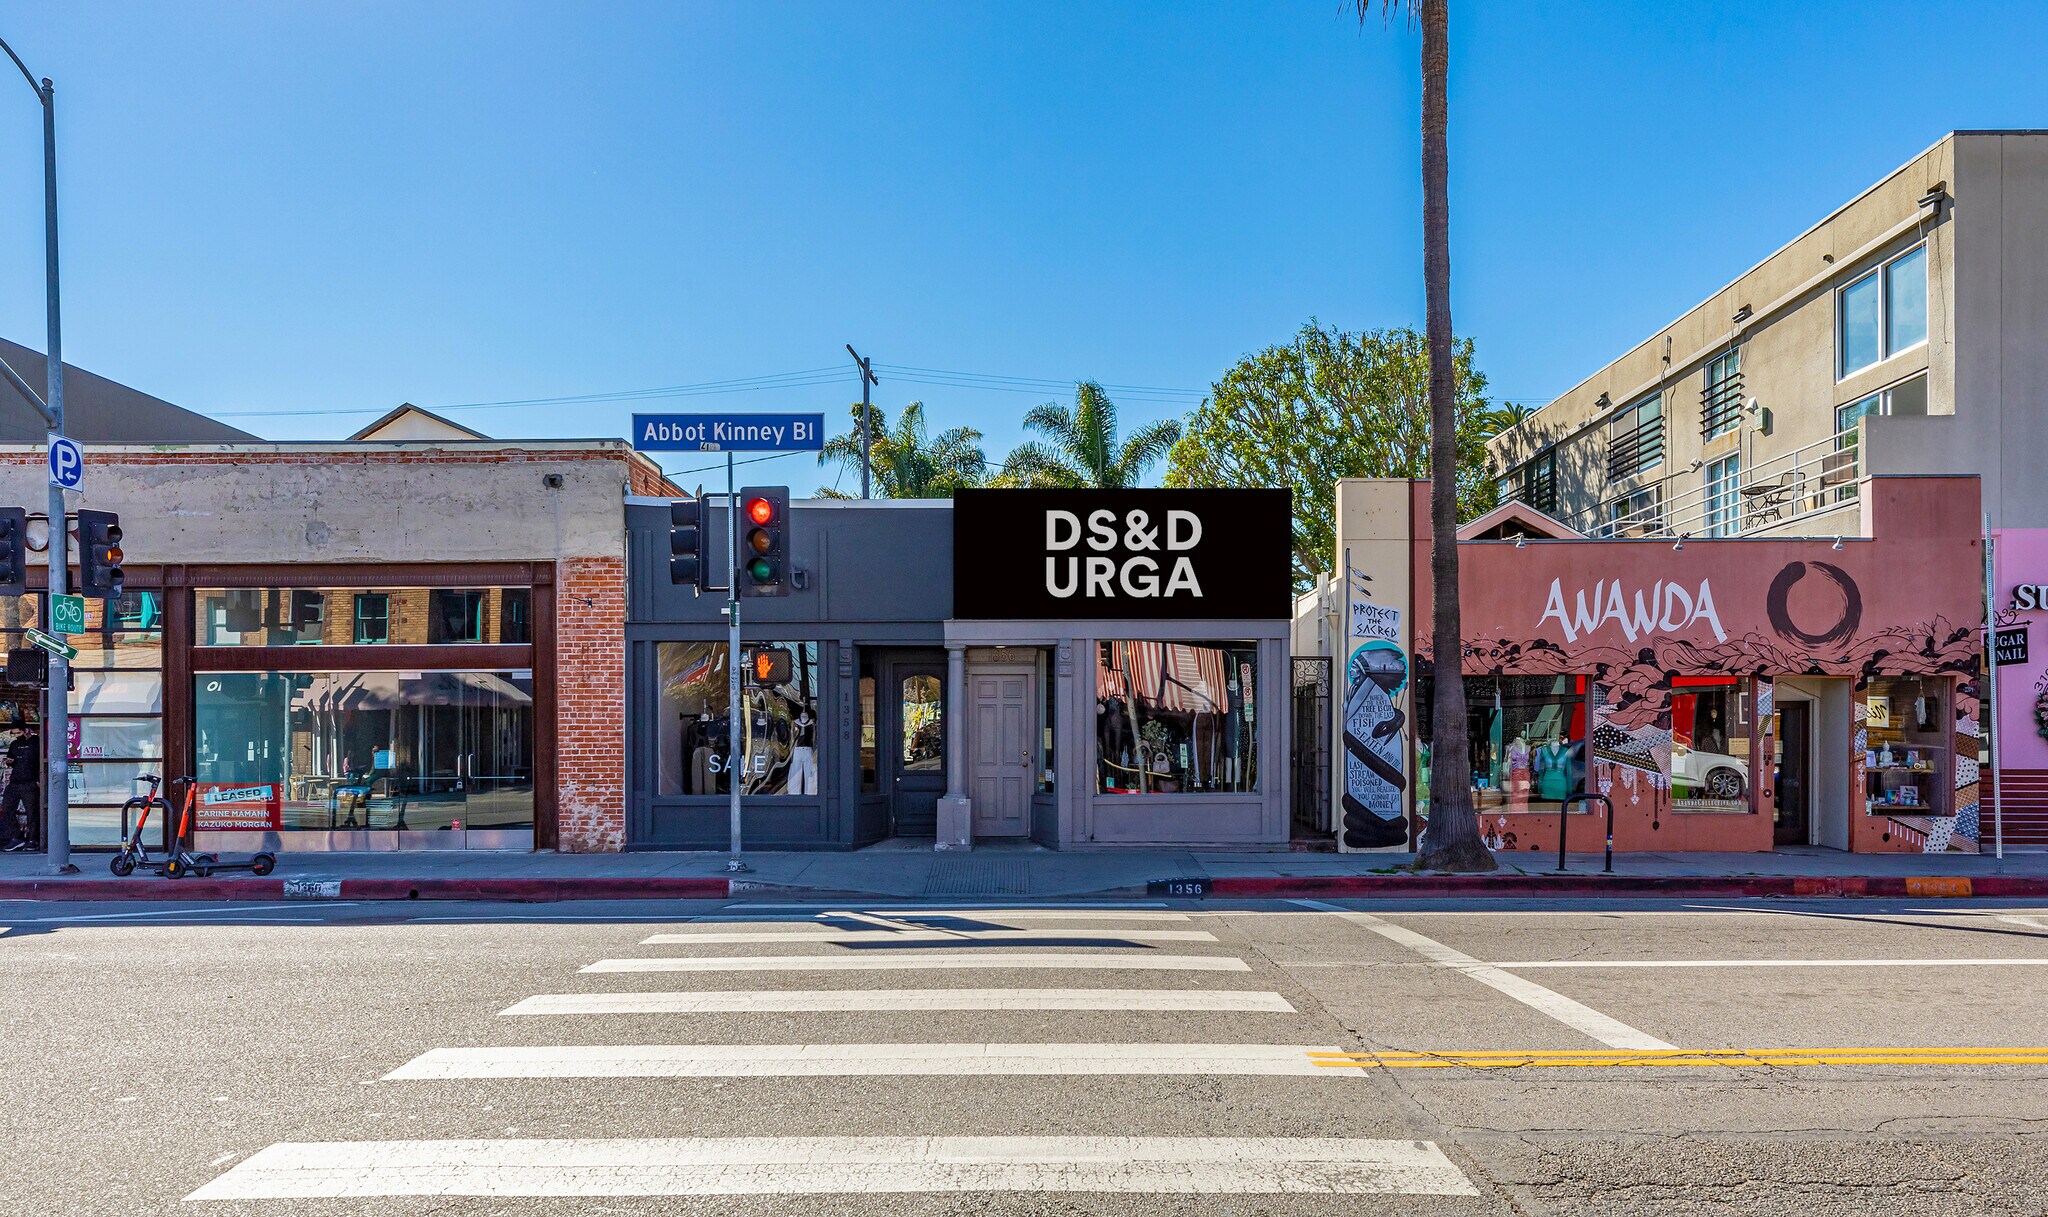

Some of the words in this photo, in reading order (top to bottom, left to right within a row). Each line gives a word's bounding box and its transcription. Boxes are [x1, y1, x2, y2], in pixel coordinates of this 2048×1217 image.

[643, 422, 706, 441] Abbot
[713, 422, 785, 446] Kinney
[57, 443, 77, 480] P
[1046, 509, 1203, 551] DS&D
[1046, 556, 1204, 598] URGA
[1353, 603, 1399, 621] PROTECT
[1535, 577, 1728, 644] ANANDA
[55, 622, 66, 631] BIKE
[67, 624, 82, 633] ROUTE
[1356, 623, 1397, 638] SACRED
[1996, 648, 2026, 662] NAIL
[1353, 718, 1374, 728] FISH
[1353, 727, 1361, 735] IS
[1359, 731, 1386, 755] EATEN
[1349, 761, 1363, 770] LAST
[1349, 770, 1376, 779] STREAM
[1351, 779, 1383, 787] POISONED
[214, 788, 261, 802] LEASED
[1169, 883, 1202, 895] 1356
